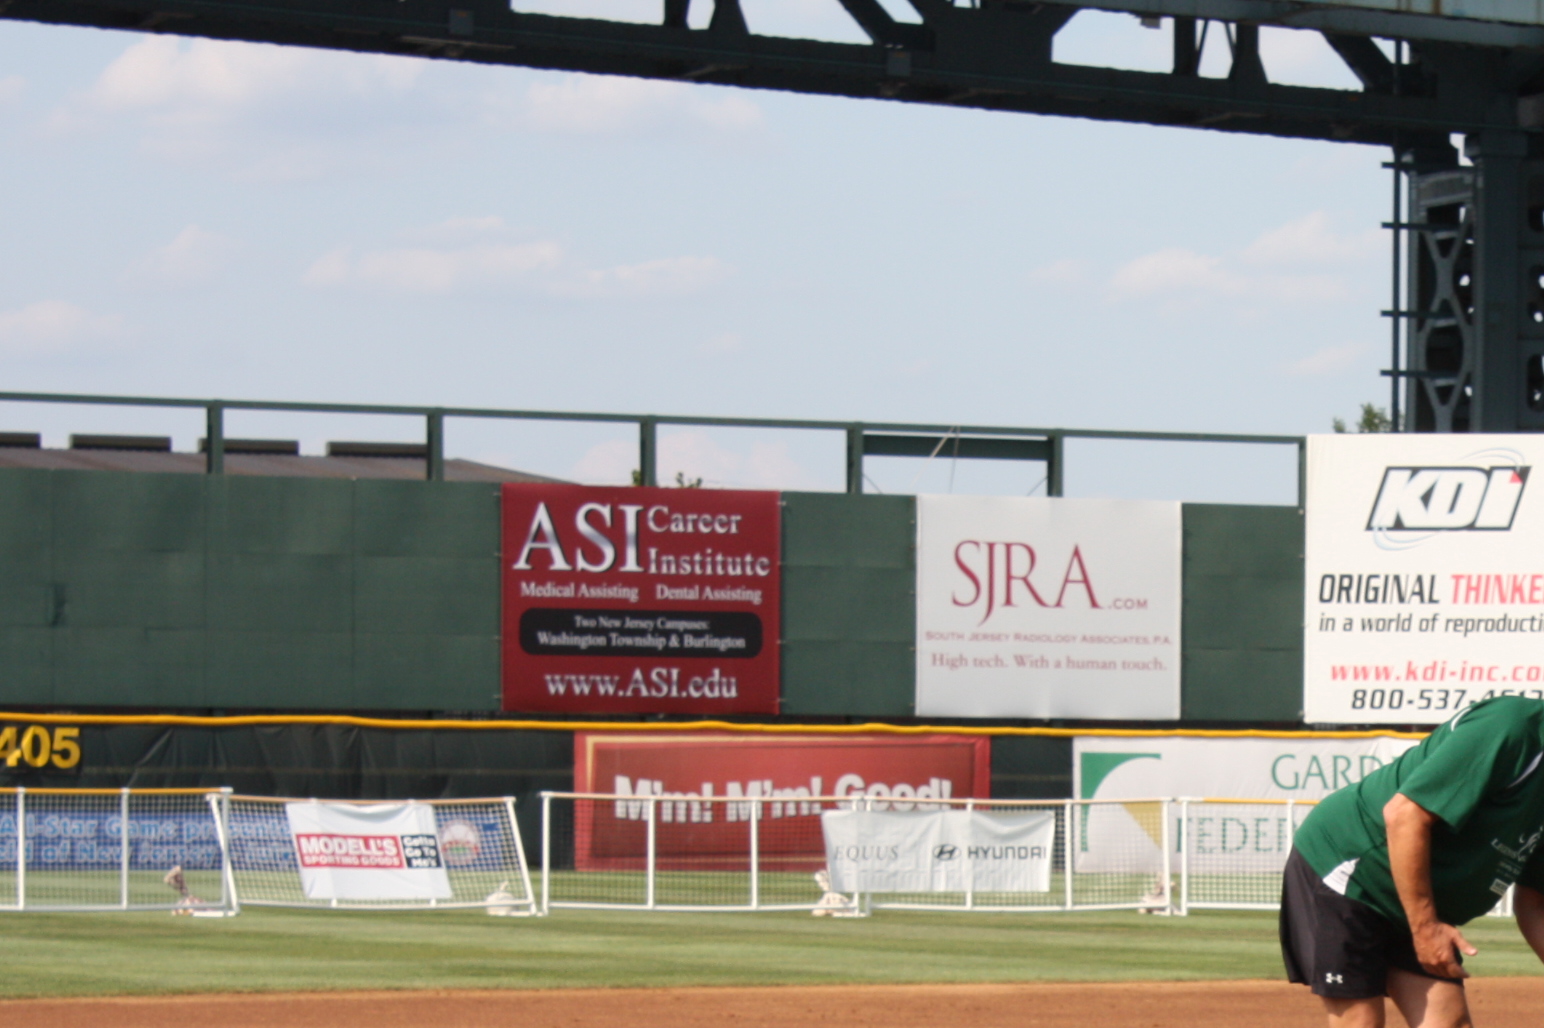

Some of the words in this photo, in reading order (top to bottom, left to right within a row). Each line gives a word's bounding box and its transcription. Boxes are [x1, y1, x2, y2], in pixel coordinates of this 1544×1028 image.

[648, 505, 741, 534] Career
[513, 502, 645, 573] ASI
[648, 548, 770, 576] Institute
[521, 581, 575, 598] Medical
[578, 583, 639, 602] Assisting
[656, 584, 699, 600] Dental
[702, 586, 762, 604] Assisting
[1319, 573, 1440, 604] ORIGINAL
[574, 616, 596, 629] Two
[599, 616, 622, 629] New
[623, 617, 655, 631] Jersey
[1319, 613, 1336, 632] in
[1343, 617, 1353, 632] a
[1361, 613, 1412, 632] world
[1419, 613, 1440, 632] of
[537, 632, 606, 649] Washington
[610, 633, 666, 650] Township
[669, 635, 680, 648] &
[684, 635, 745, 651] Burlington
[925, 631, 965, 642] SOUTH
[969, 632, 1010, 643] JERSEY
[1013, 632, 1076, 644] RADIOLOGY
[932, 653, 968, 671] High
[973, 654, 1008, 668] tech.
[1013, 654, 1049, 669] With
[1054, 659, 1062, 669] a
[1066, 656, 1117, 670] human
[1122, 657, 1167, 671] touch.
[545, 667, 738, 698] www.ASI.edu
[1352, 689, 1543, 710] 800-537-4
[0, 726, 81, 769] 405
[1271, 754, 1398, 790] GARD
[834, 773, 953, 812] Good!
[0, 814, 98, 838] Al-Star
[300, 836, 399, 857] MODELL'S
[404, 847, 421, 858] Go
[422, 847, 437, 857] To
[833, 844, 900, 862] EQUUS
[968, 846, 1048, 860] HYUNDAI
[304, 855, 360, 866] SPORTING
[361, 856, 401, 866] GOODS
